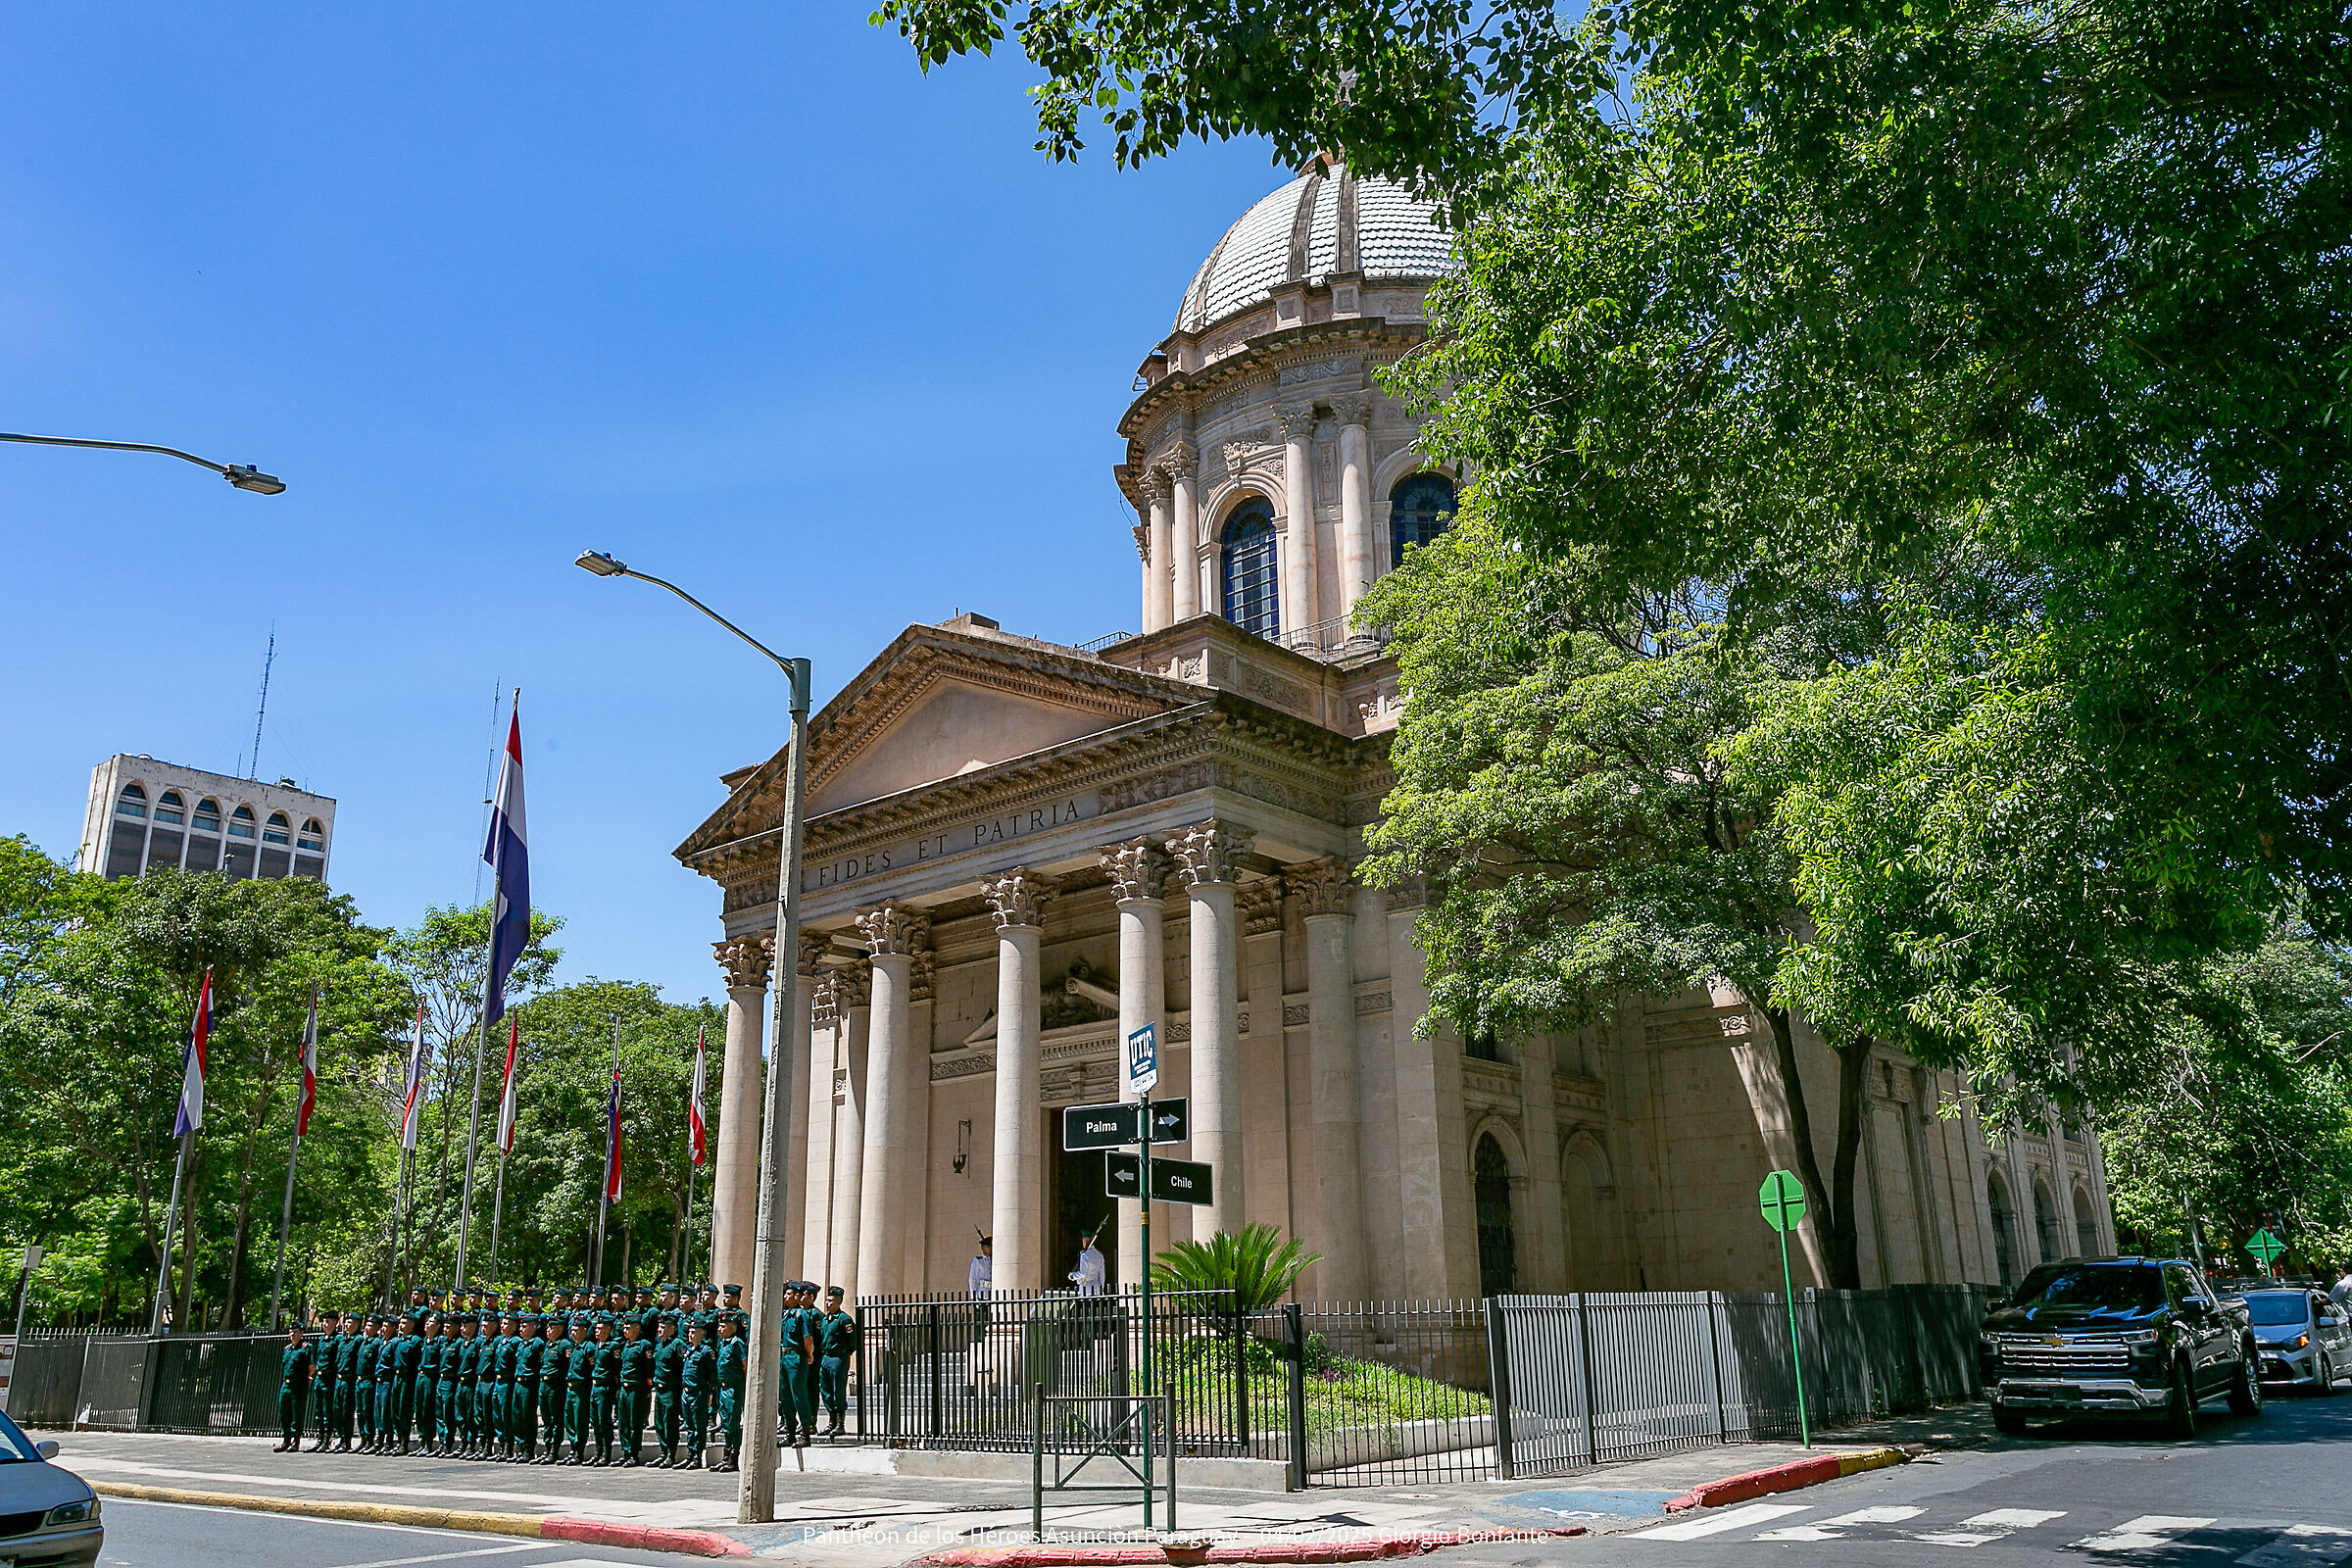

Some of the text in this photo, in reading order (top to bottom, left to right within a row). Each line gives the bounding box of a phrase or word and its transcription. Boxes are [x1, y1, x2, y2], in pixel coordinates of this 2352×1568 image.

[818, 800, 1080, 886] FIDES ET PATRIA
[1130, 1029, 1153, 1067] UTIC
[1086, 1120, 1118, 1134] Palma
[1170, 1175, 1193, 1189] Chile
